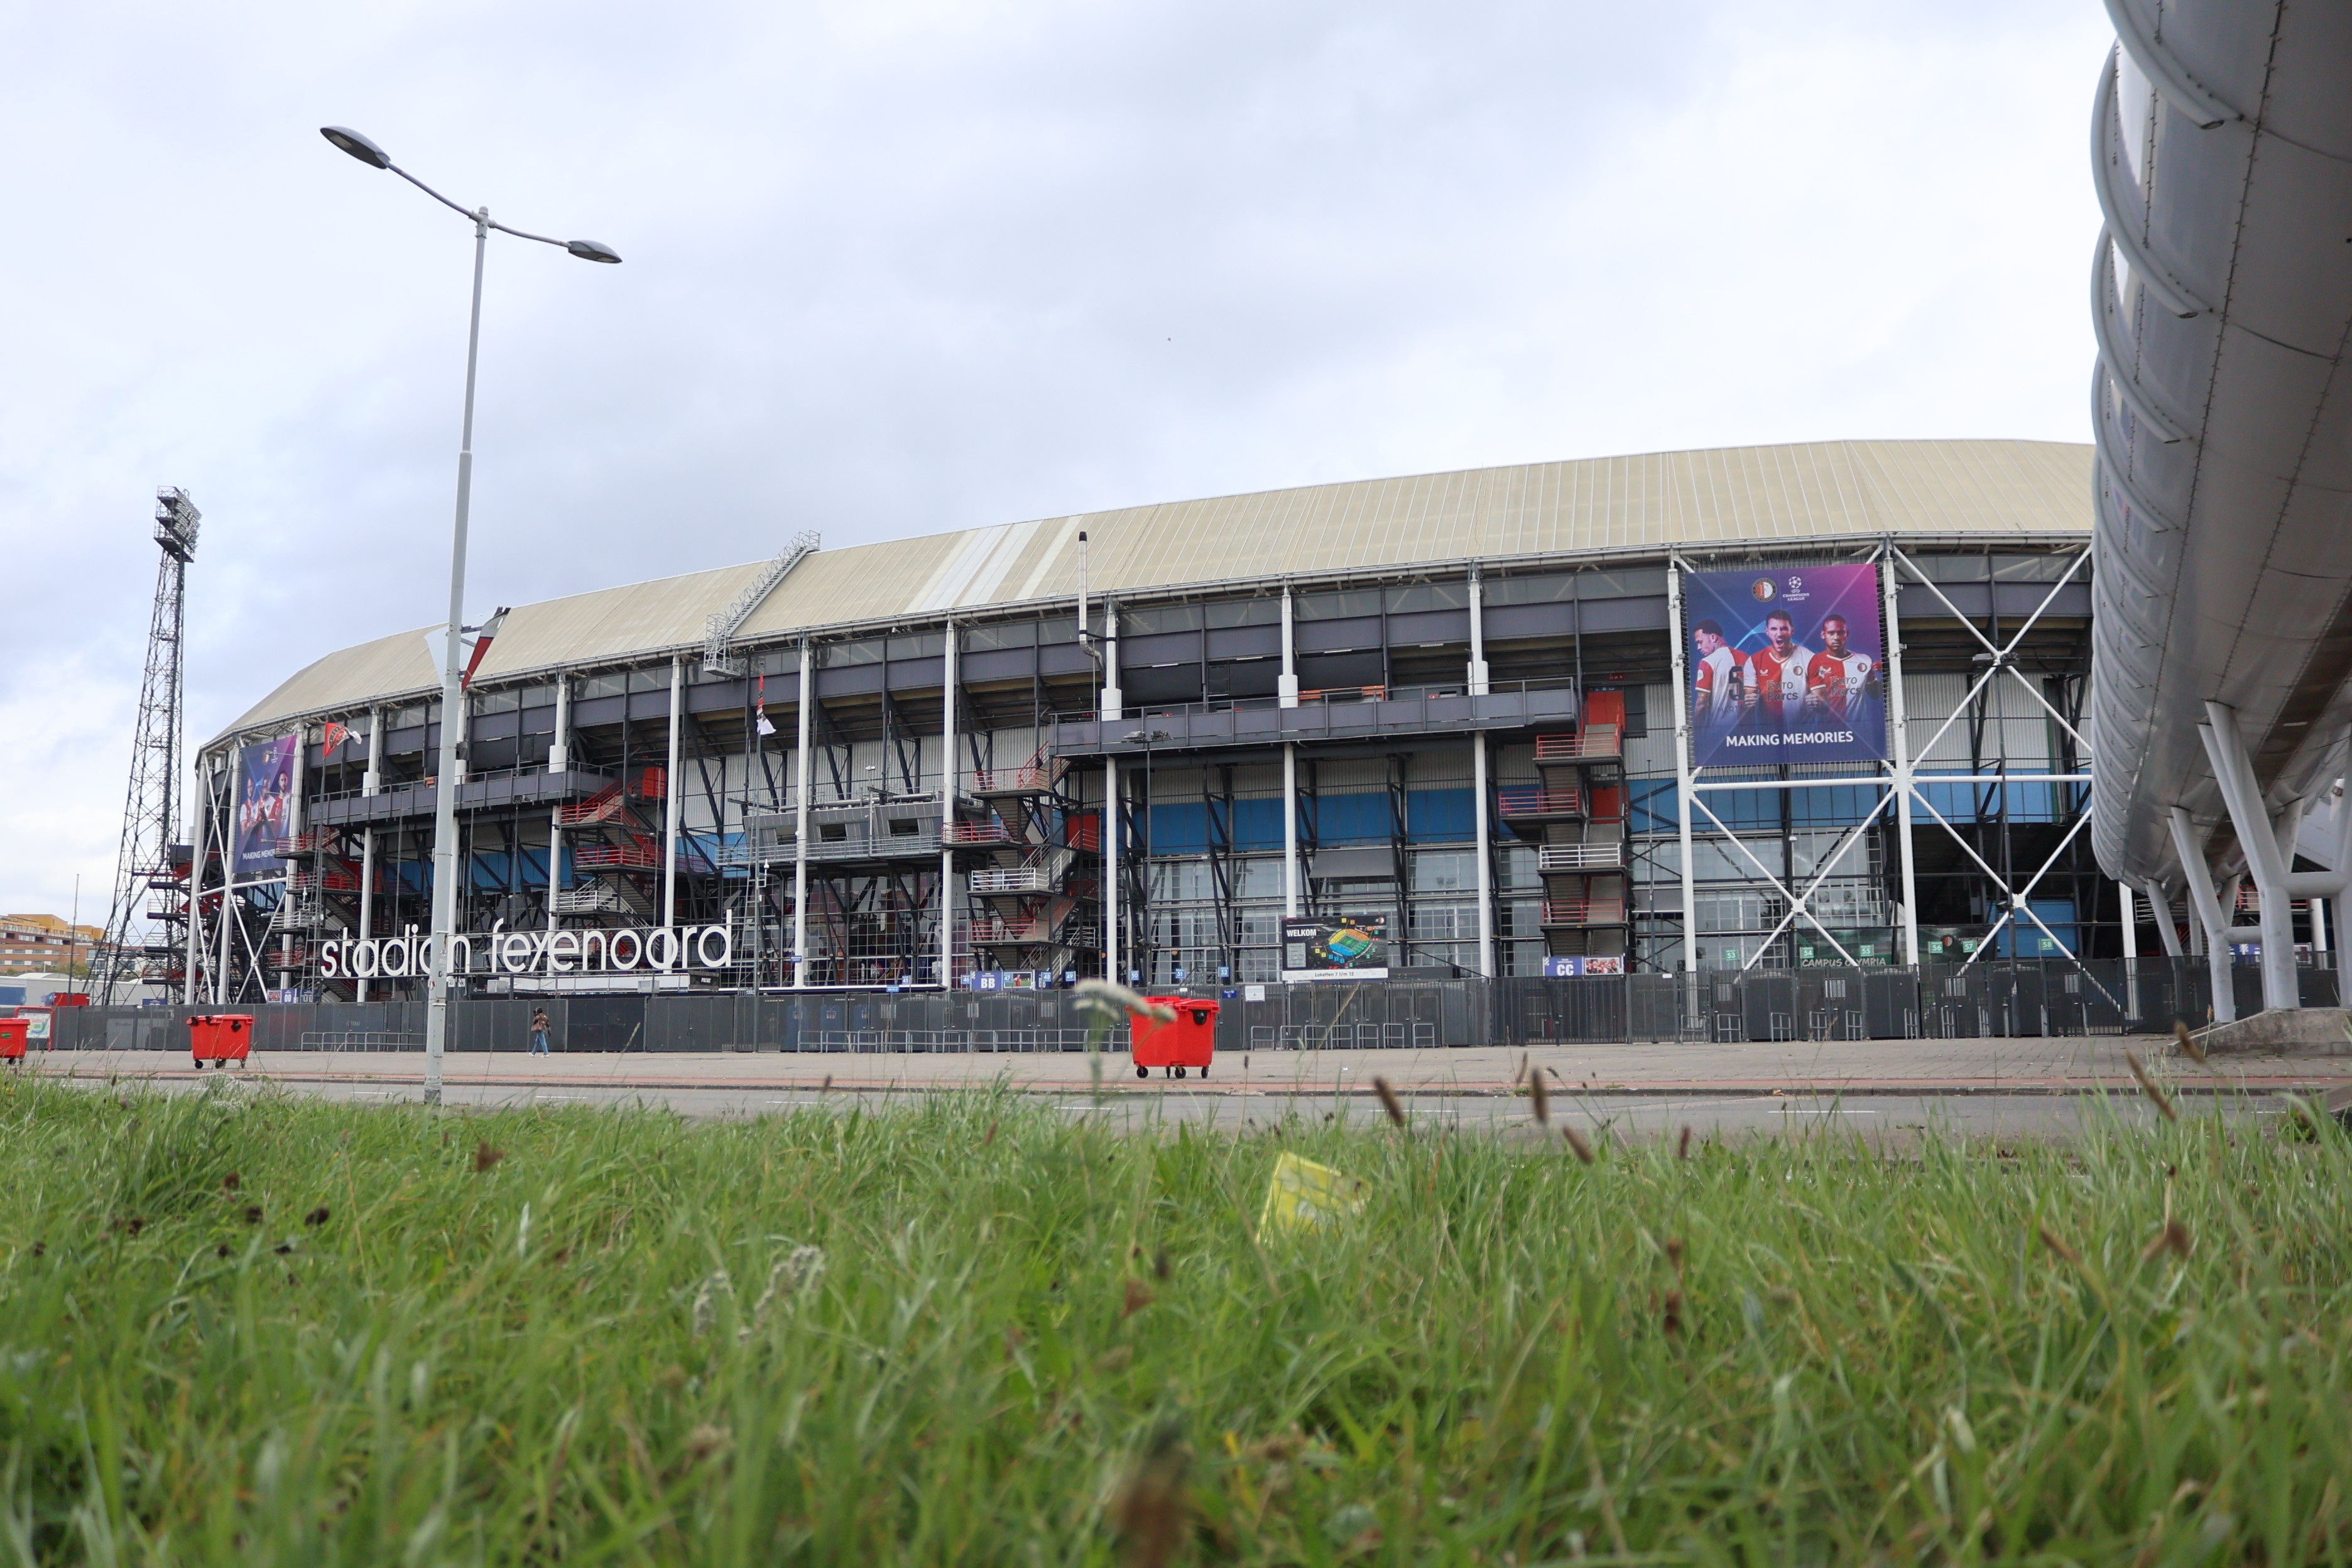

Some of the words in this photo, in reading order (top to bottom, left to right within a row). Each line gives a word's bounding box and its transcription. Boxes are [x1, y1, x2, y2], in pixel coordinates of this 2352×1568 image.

[1767, 680, 1794, 690] Euro
[1831, 676, 1858, 687] Euro
[1767, 692, 1798, 701] Parcs
[1831, 687, 1861, 696] Parcs
[1726, 734, 1780, 747] MAKING
[1783, 731, 1853, 744] MEMORIES
[242, 851, 261, 860] MAKING
[1287, 929, 1317, 937] WELKOM
[491, 909, 732, 973] feyenoord
[1802, 959, 1843, 967] CAMPUS
[1557, 964, 1574, 976] CC
[981, 978, 995, 989] BB
